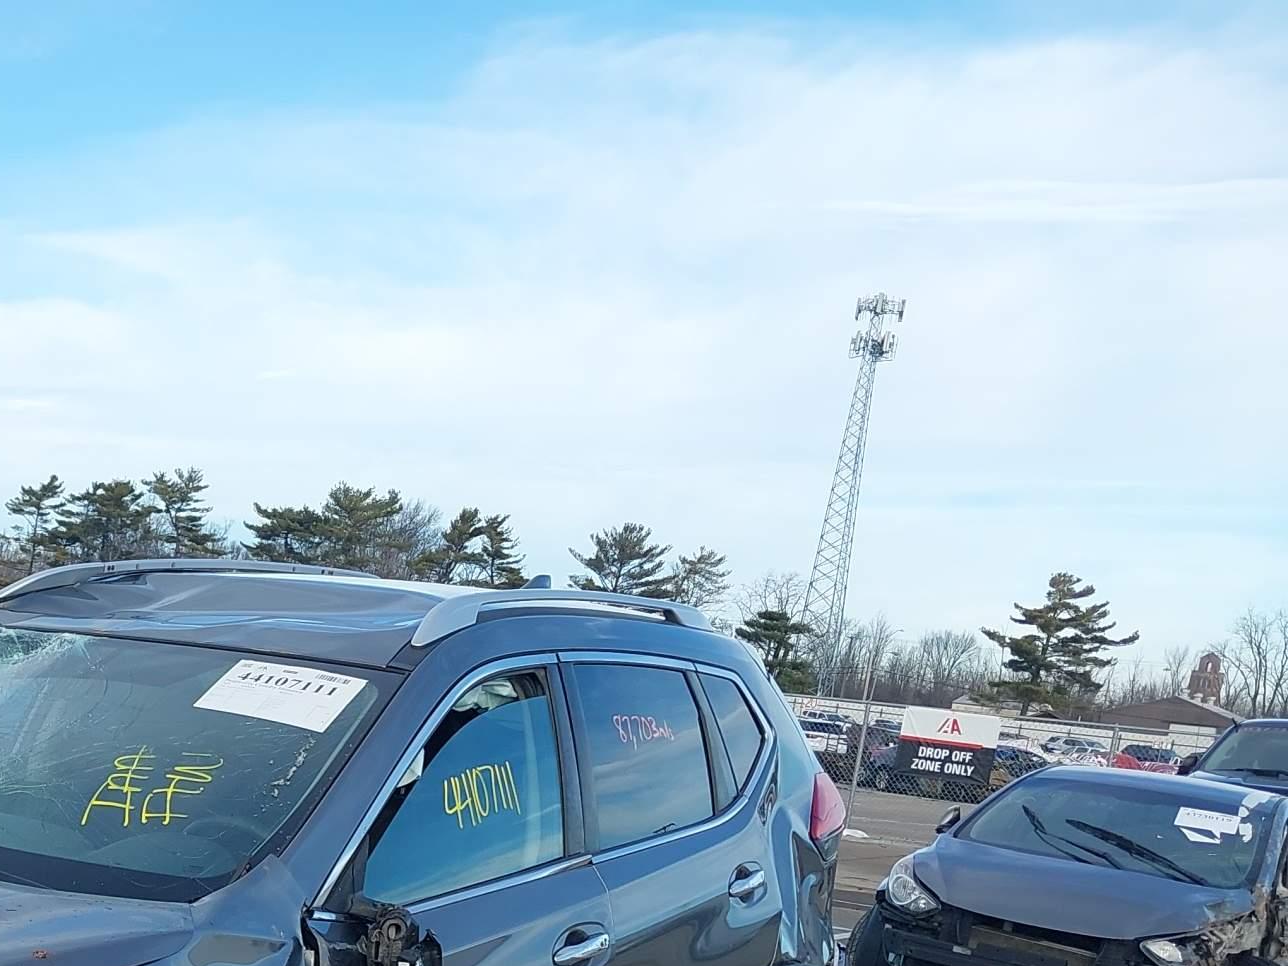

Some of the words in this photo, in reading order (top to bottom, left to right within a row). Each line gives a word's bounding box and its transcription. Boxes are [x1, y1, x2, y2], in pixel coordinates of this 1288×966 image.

[237, 671, 339, 697] 44107111
[917, 746, 950, 761] DROP
[951, 751, 974, 764] OFF
[910, 758, 943, 773] ZONE
[943, 763, 976, 777] ONLY
[442, 760, 521, 829] 44107111
